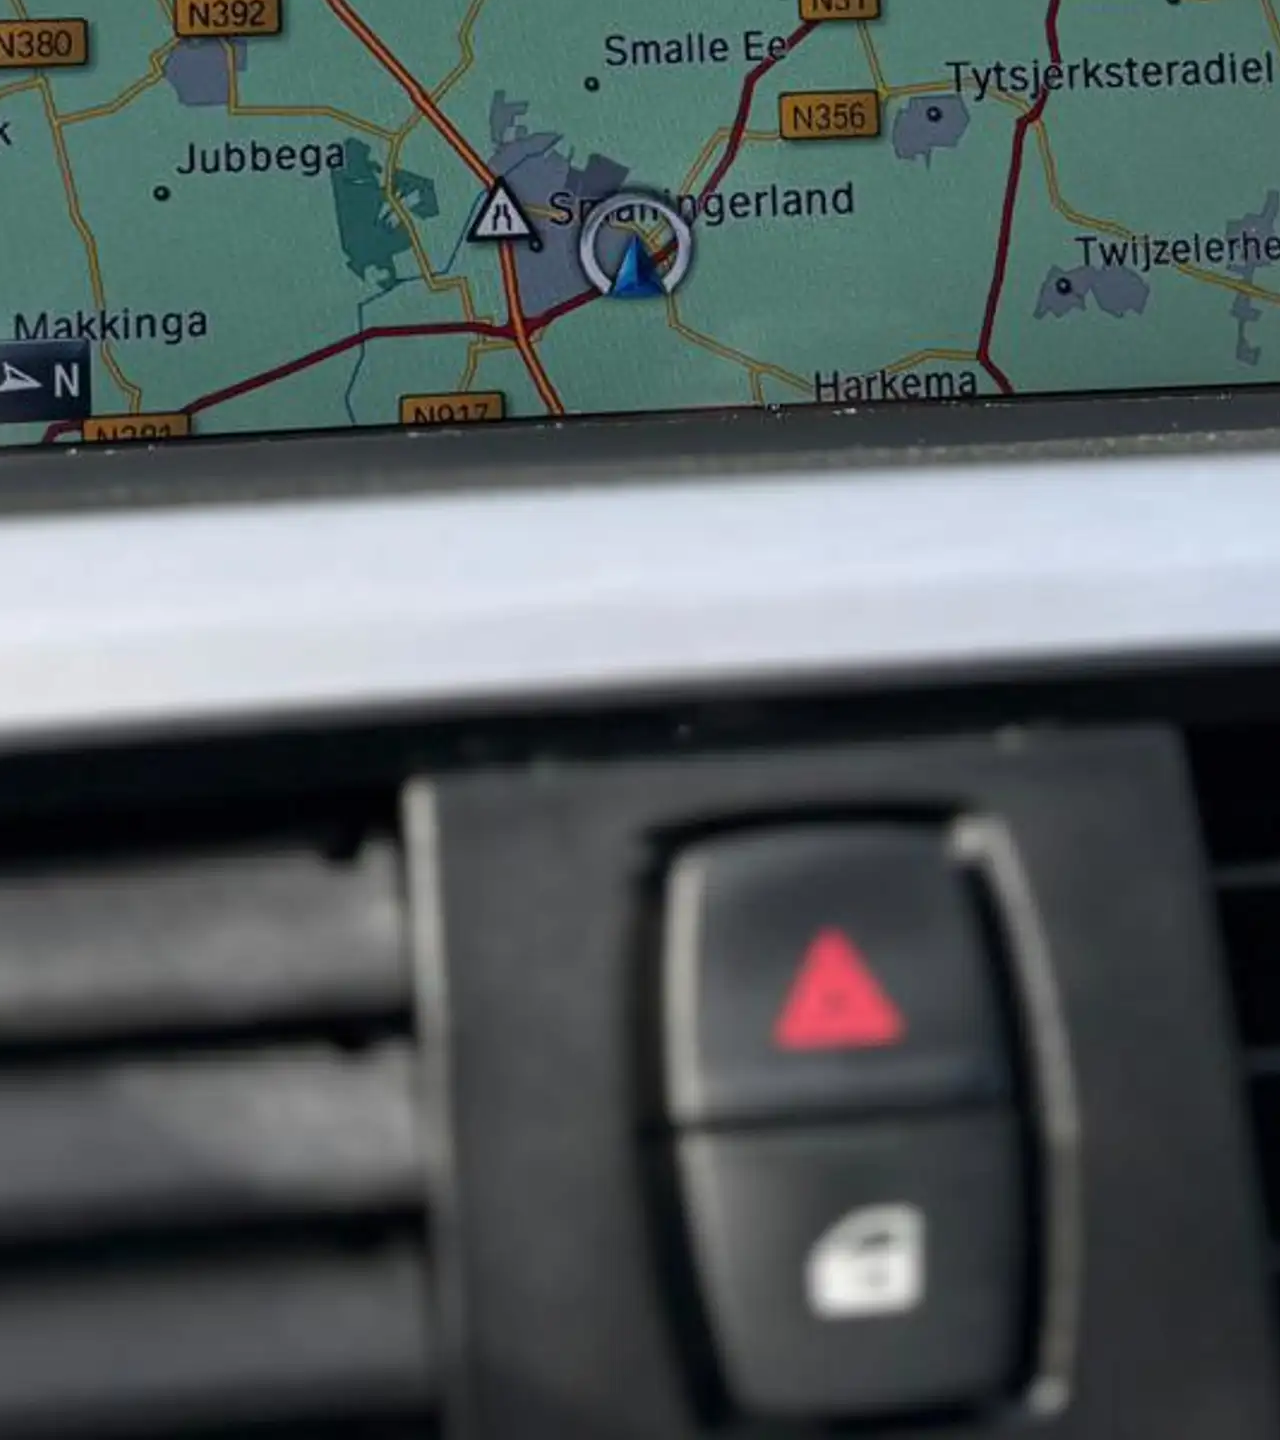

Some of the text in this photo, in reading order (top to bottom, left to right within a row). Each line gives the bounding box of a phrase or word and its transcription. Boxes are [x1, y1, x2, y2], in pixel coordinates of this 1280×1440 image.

[188, 0, 266, 29] N392
[605, 31, 788, 66] Smalle Ee
[946, 51, 1274, 101] Tytsjerksteradiel
[793, 102, 866, 132] N356
[177, 138, 346, 176] Jubbega
[14, 307, 207, 346] Makkinga
[54, 363, 80, 398] N
[814, 369, 978, 403] Harkema
